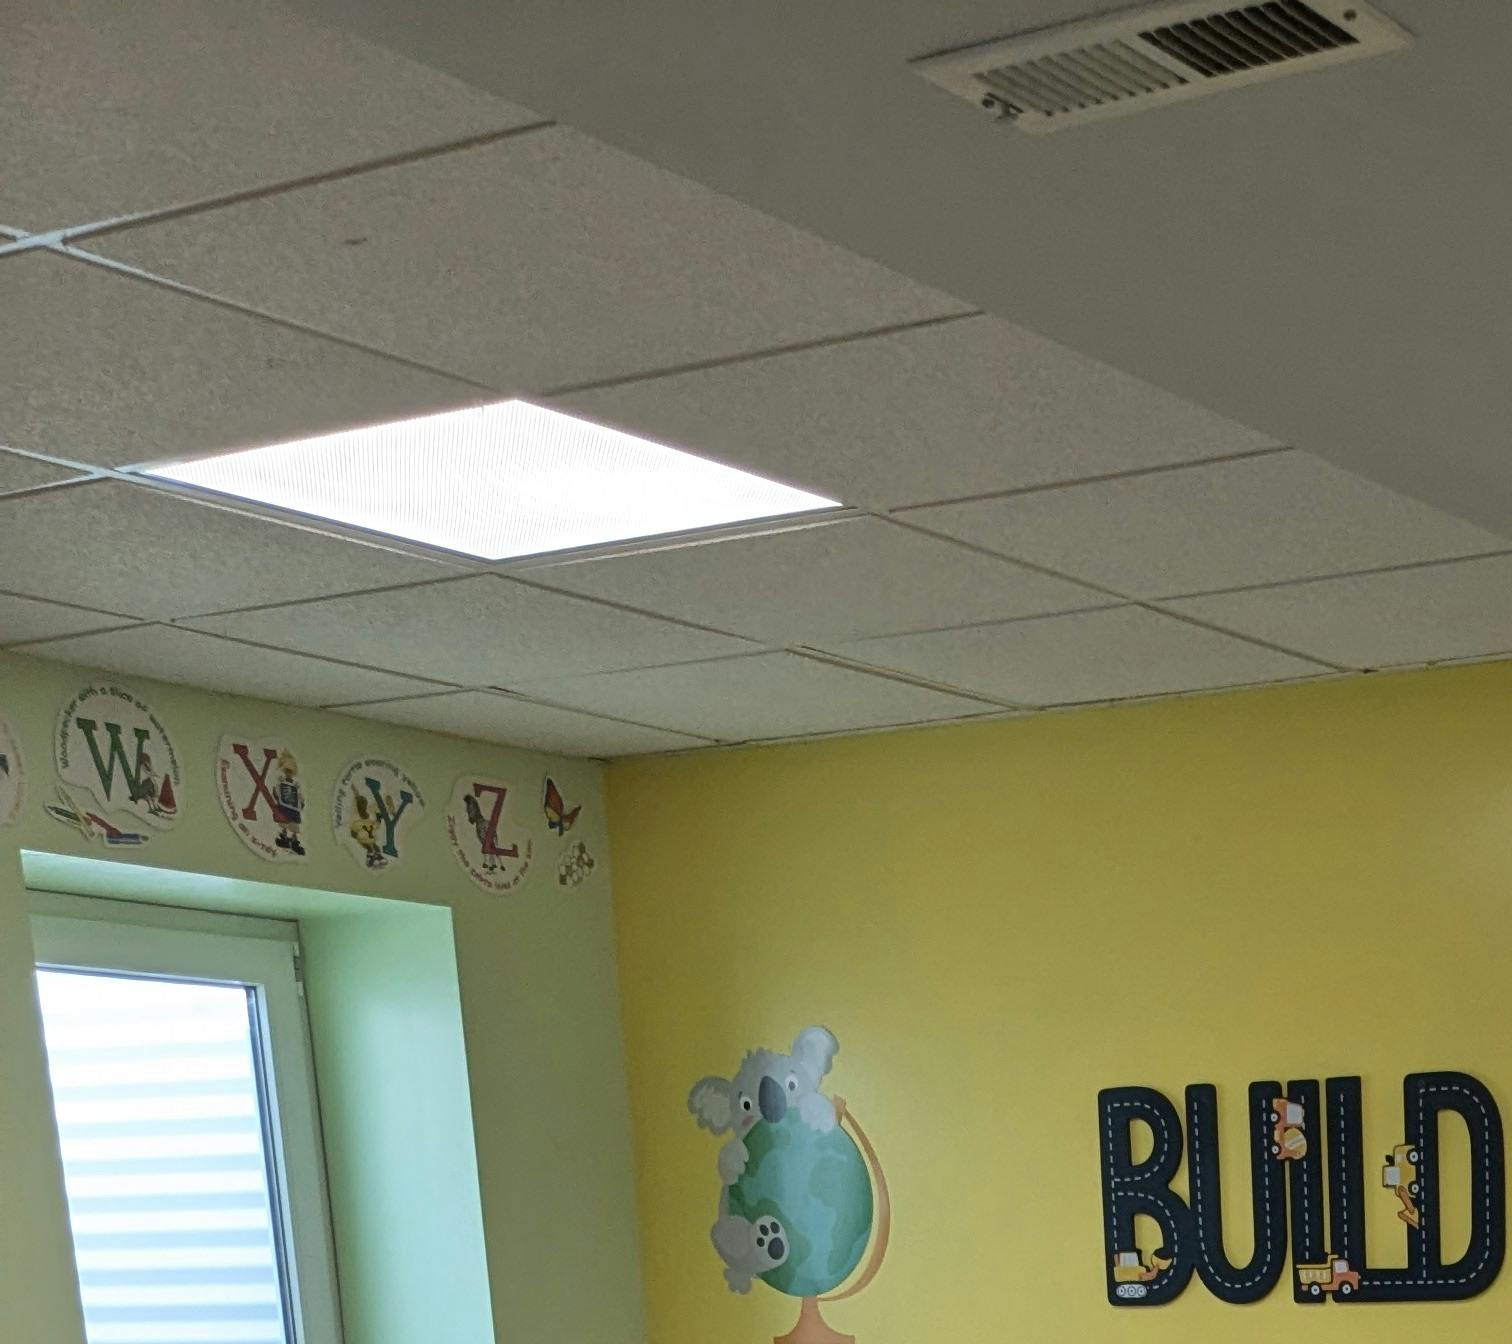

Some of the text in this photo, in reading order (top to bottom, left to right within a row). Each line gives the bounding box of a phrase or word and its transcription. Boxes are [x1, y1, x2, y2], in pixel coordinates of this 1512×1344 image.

[76, 717, 150, 802] W
[232, 743, 290, 823] X
[365, 777, 413, 857] Y
[473, 783, 518, 857] Z
[1098, 1071, 1506, 1306] BUILD
